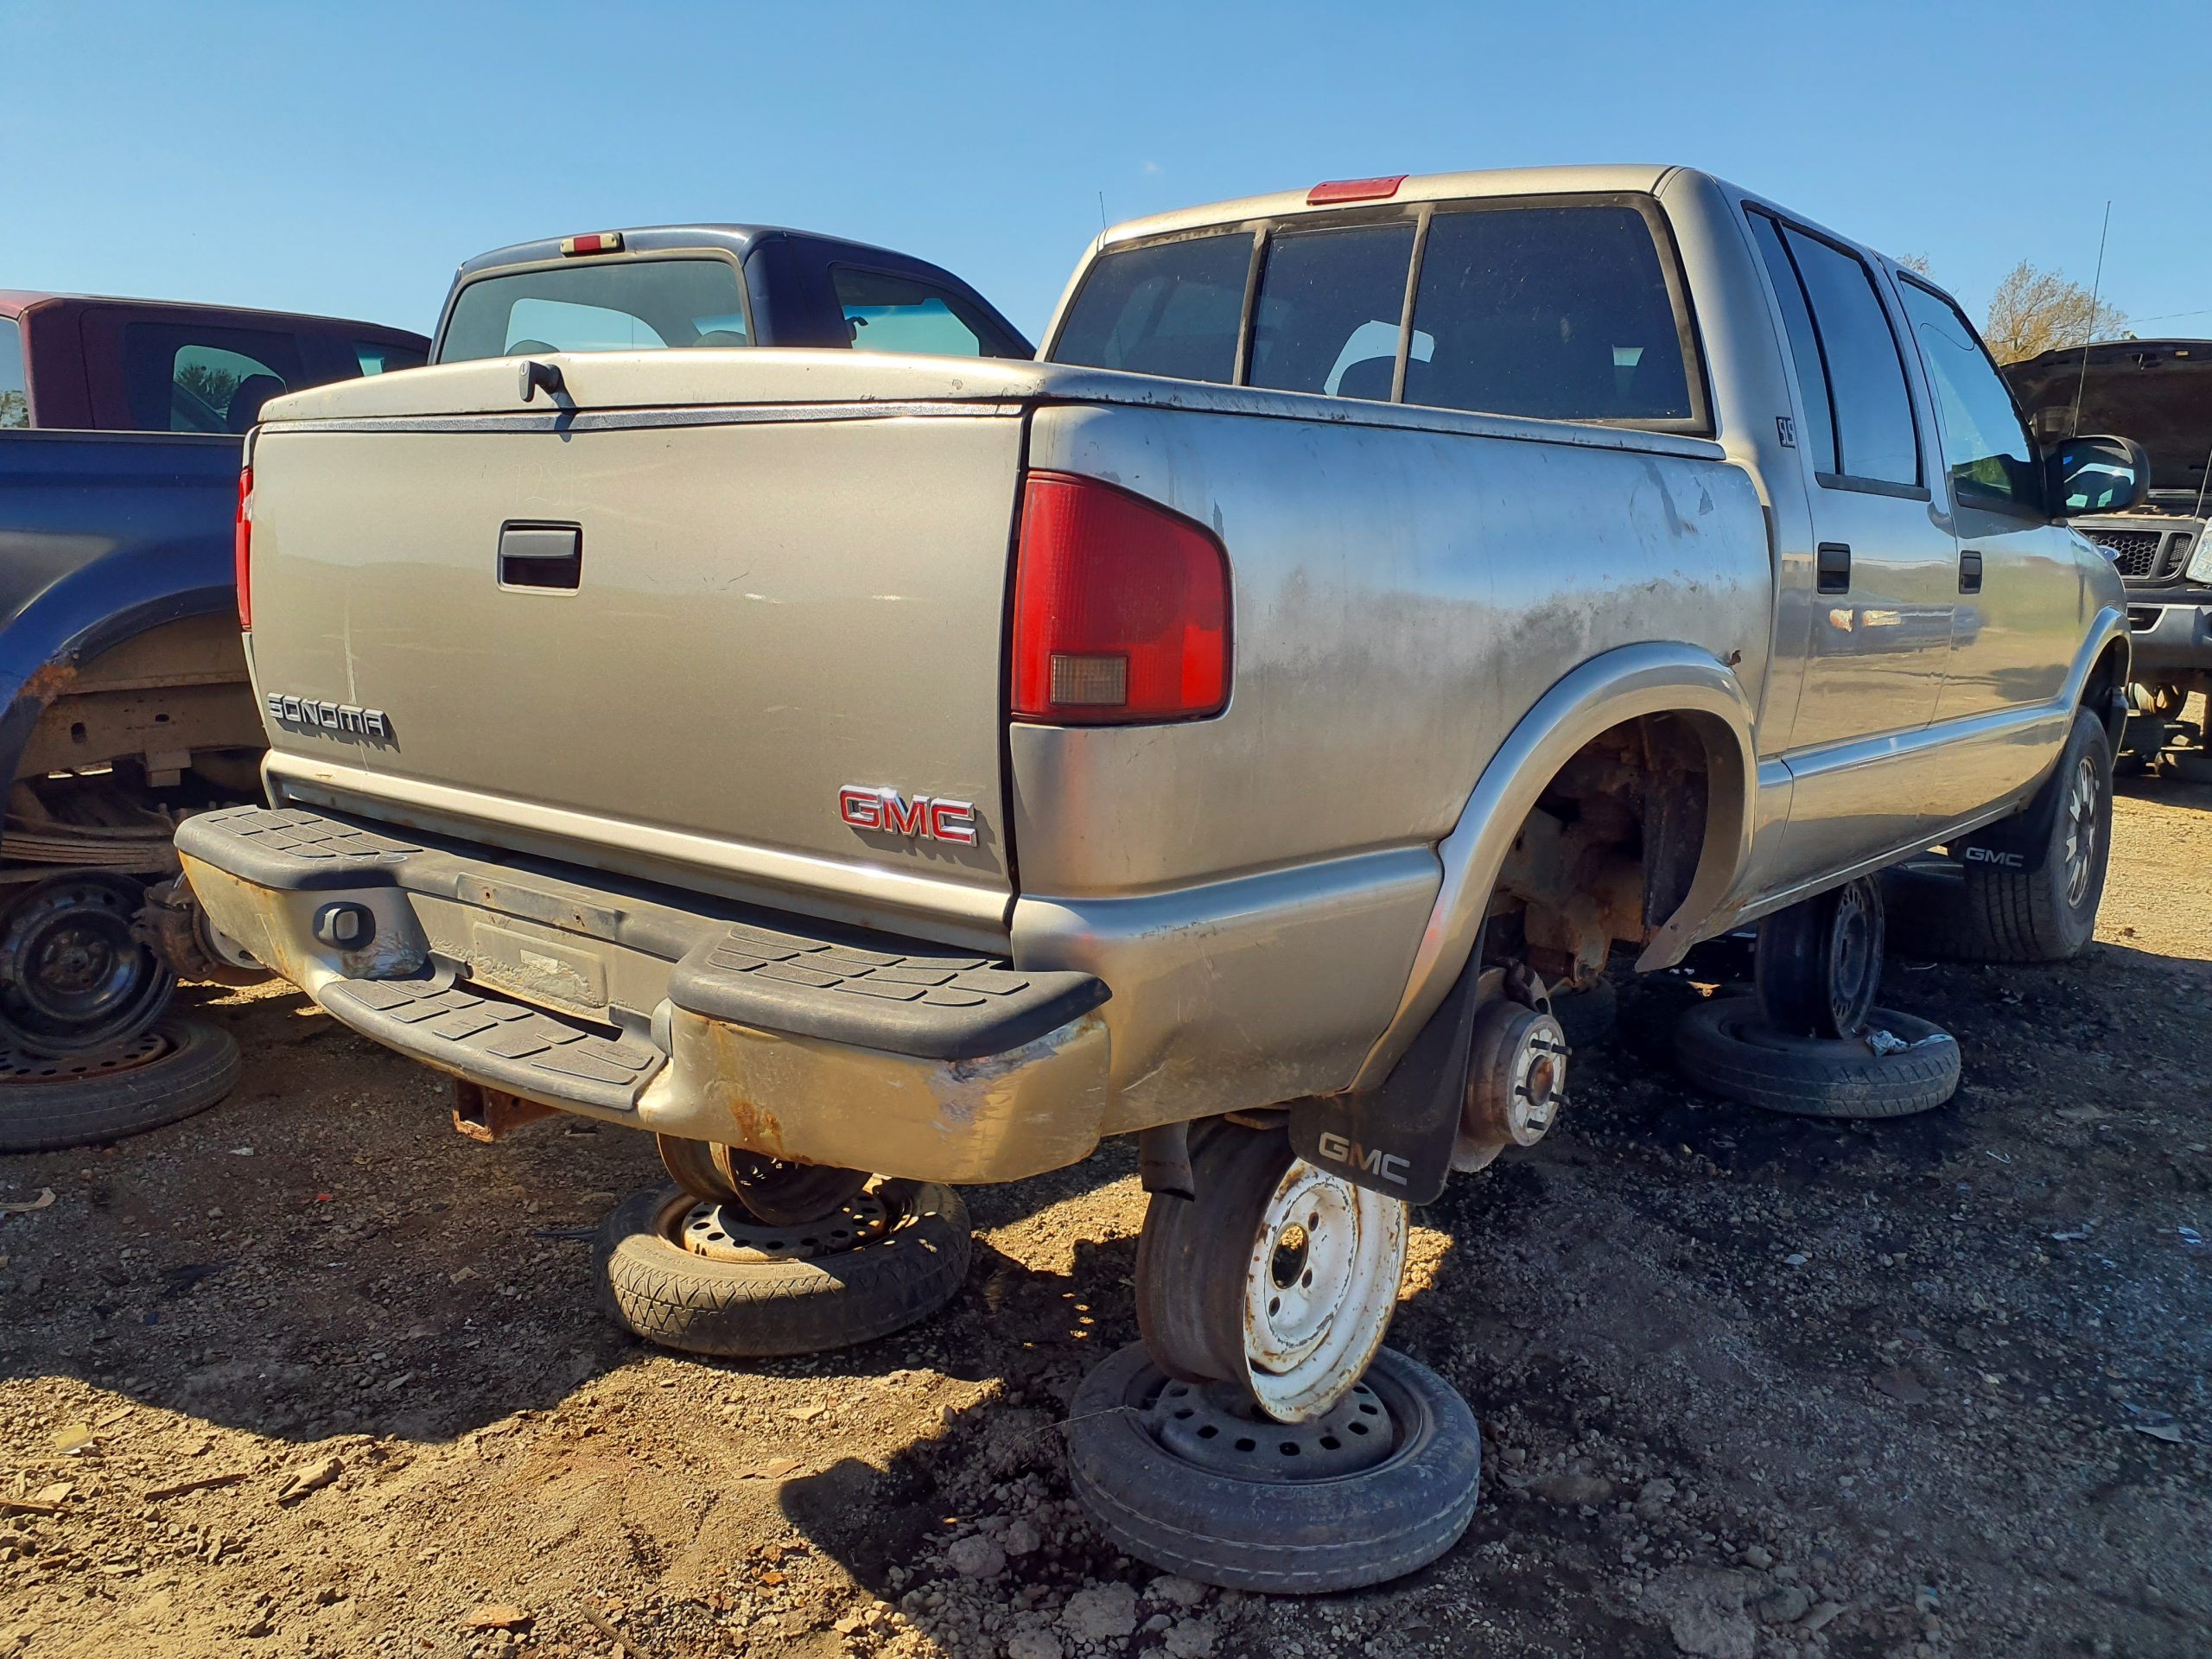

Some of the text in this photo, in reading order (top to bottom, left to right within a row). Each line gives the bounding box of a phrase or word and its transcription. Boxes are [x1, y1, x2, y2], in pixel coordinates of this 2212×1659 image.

[267, 692, 386, 737] SONOMA
[838, 785, 977, 847] GMC
[1965, 847, 2024, 868] GMC
[1319, 1132, 1410, 1186] GMC
